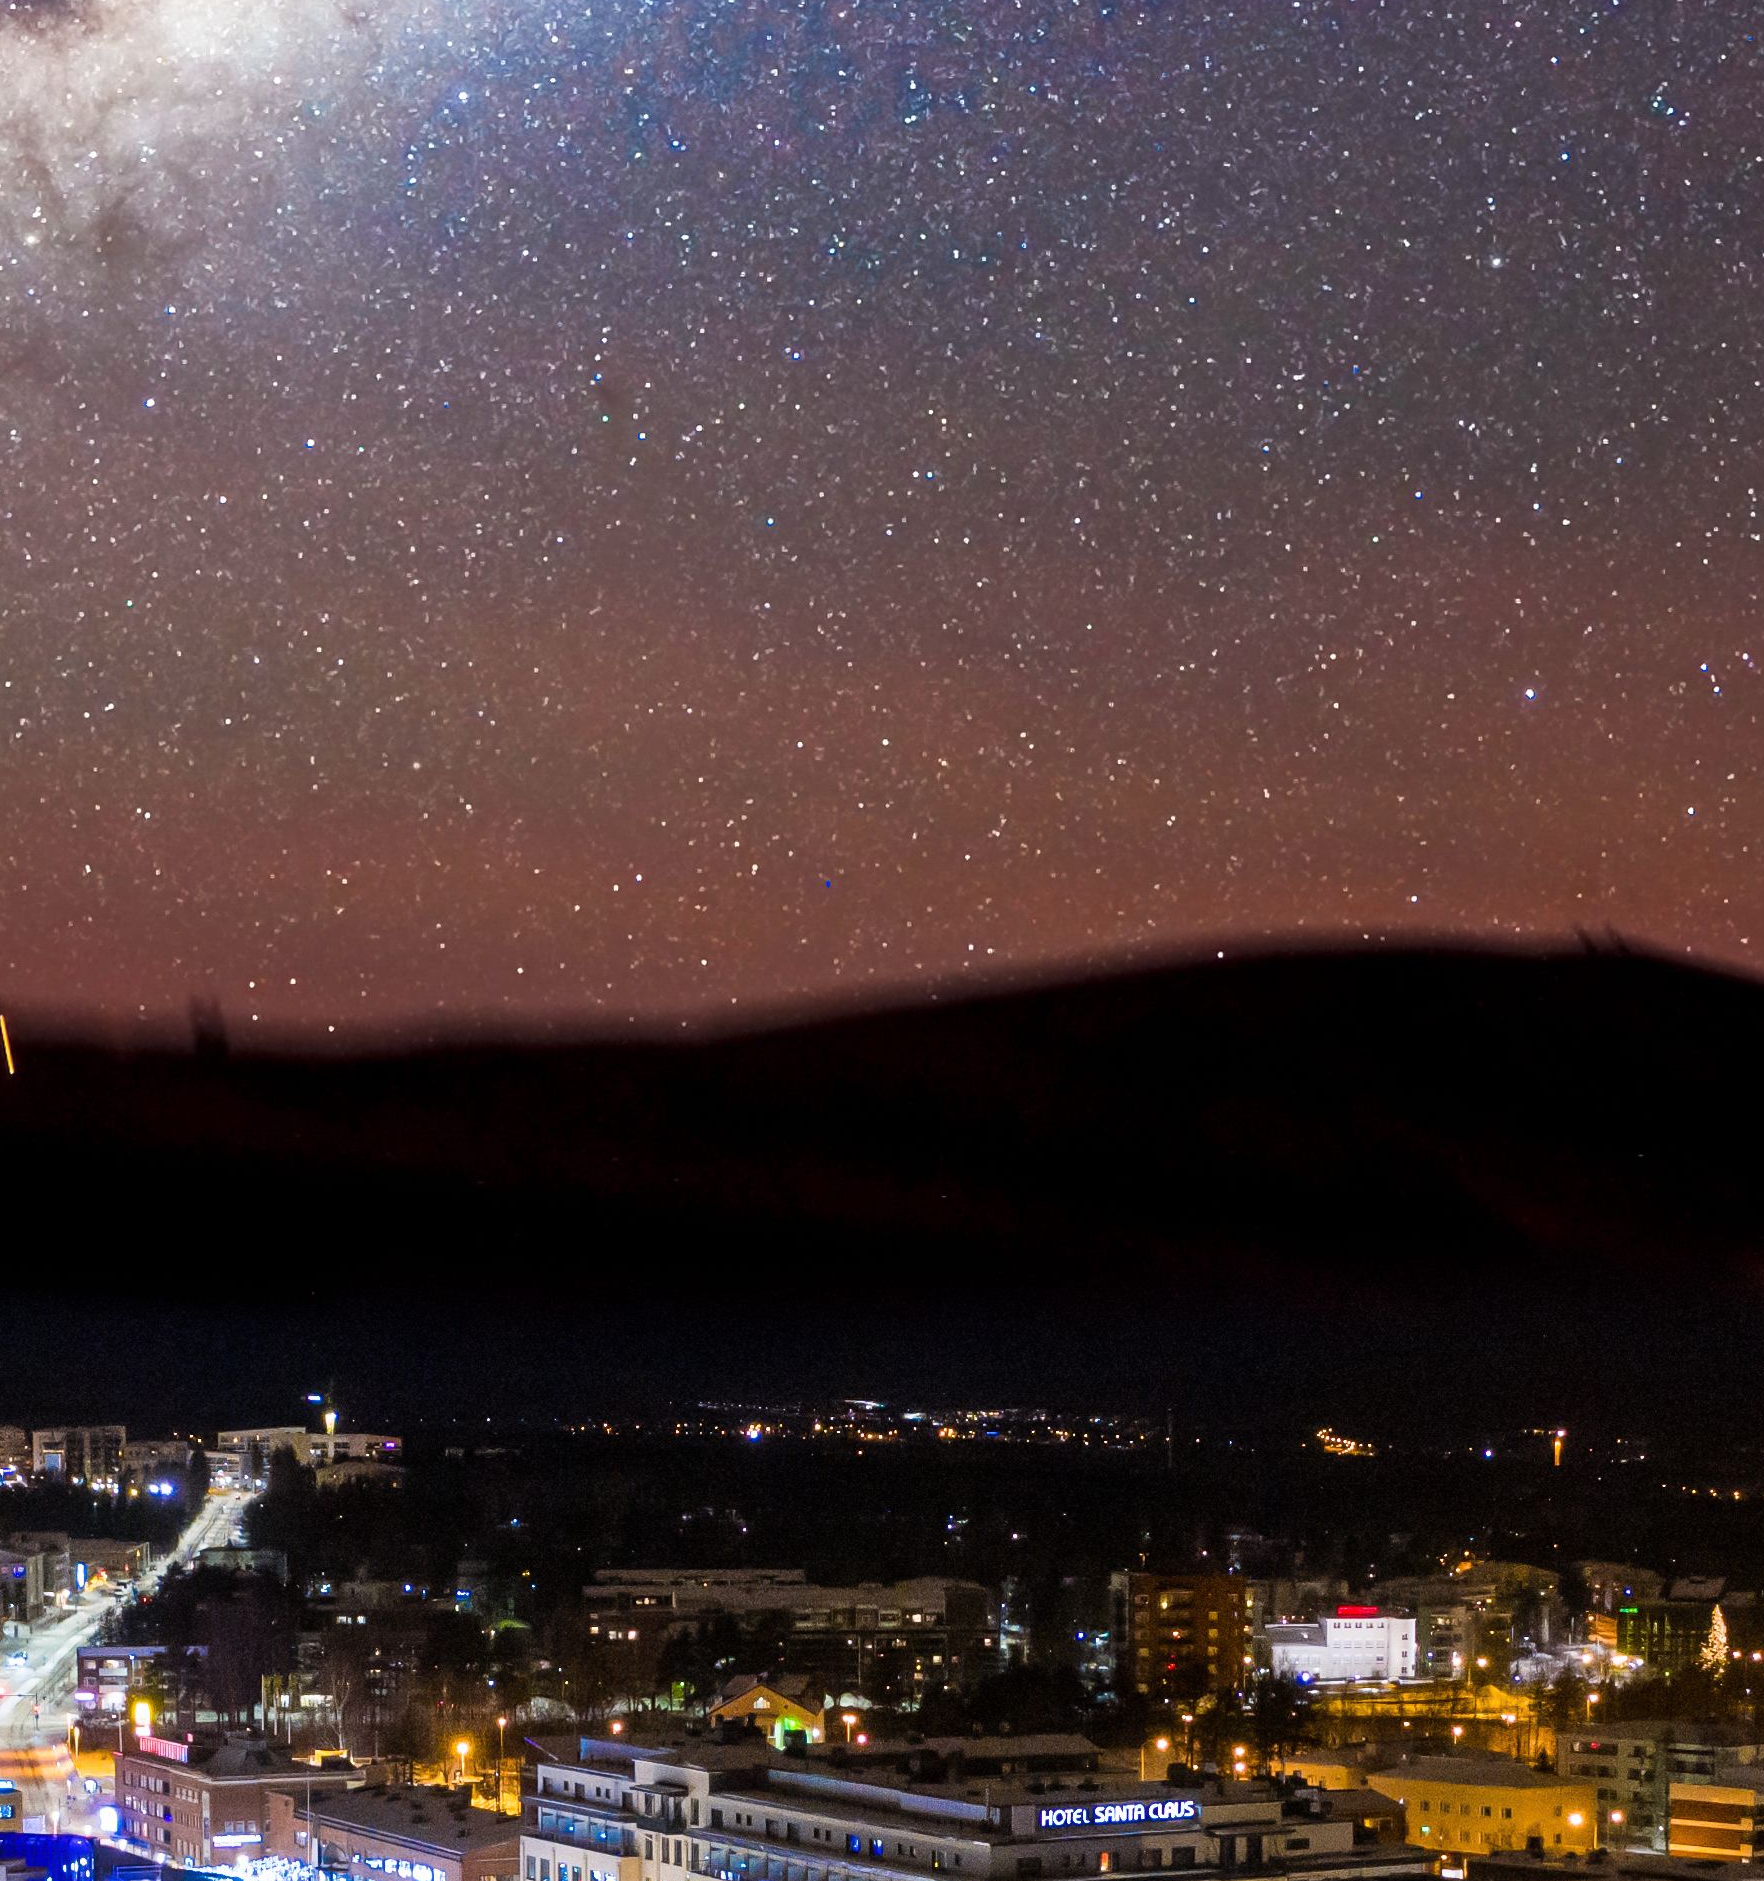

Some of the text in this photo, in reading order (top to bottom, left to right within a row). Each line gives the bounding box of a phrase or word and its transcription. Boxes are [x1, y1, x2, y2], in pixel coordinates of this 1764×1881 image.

[1041, 1800, 1195, 1827] HOTEL SANTA CLAUS
